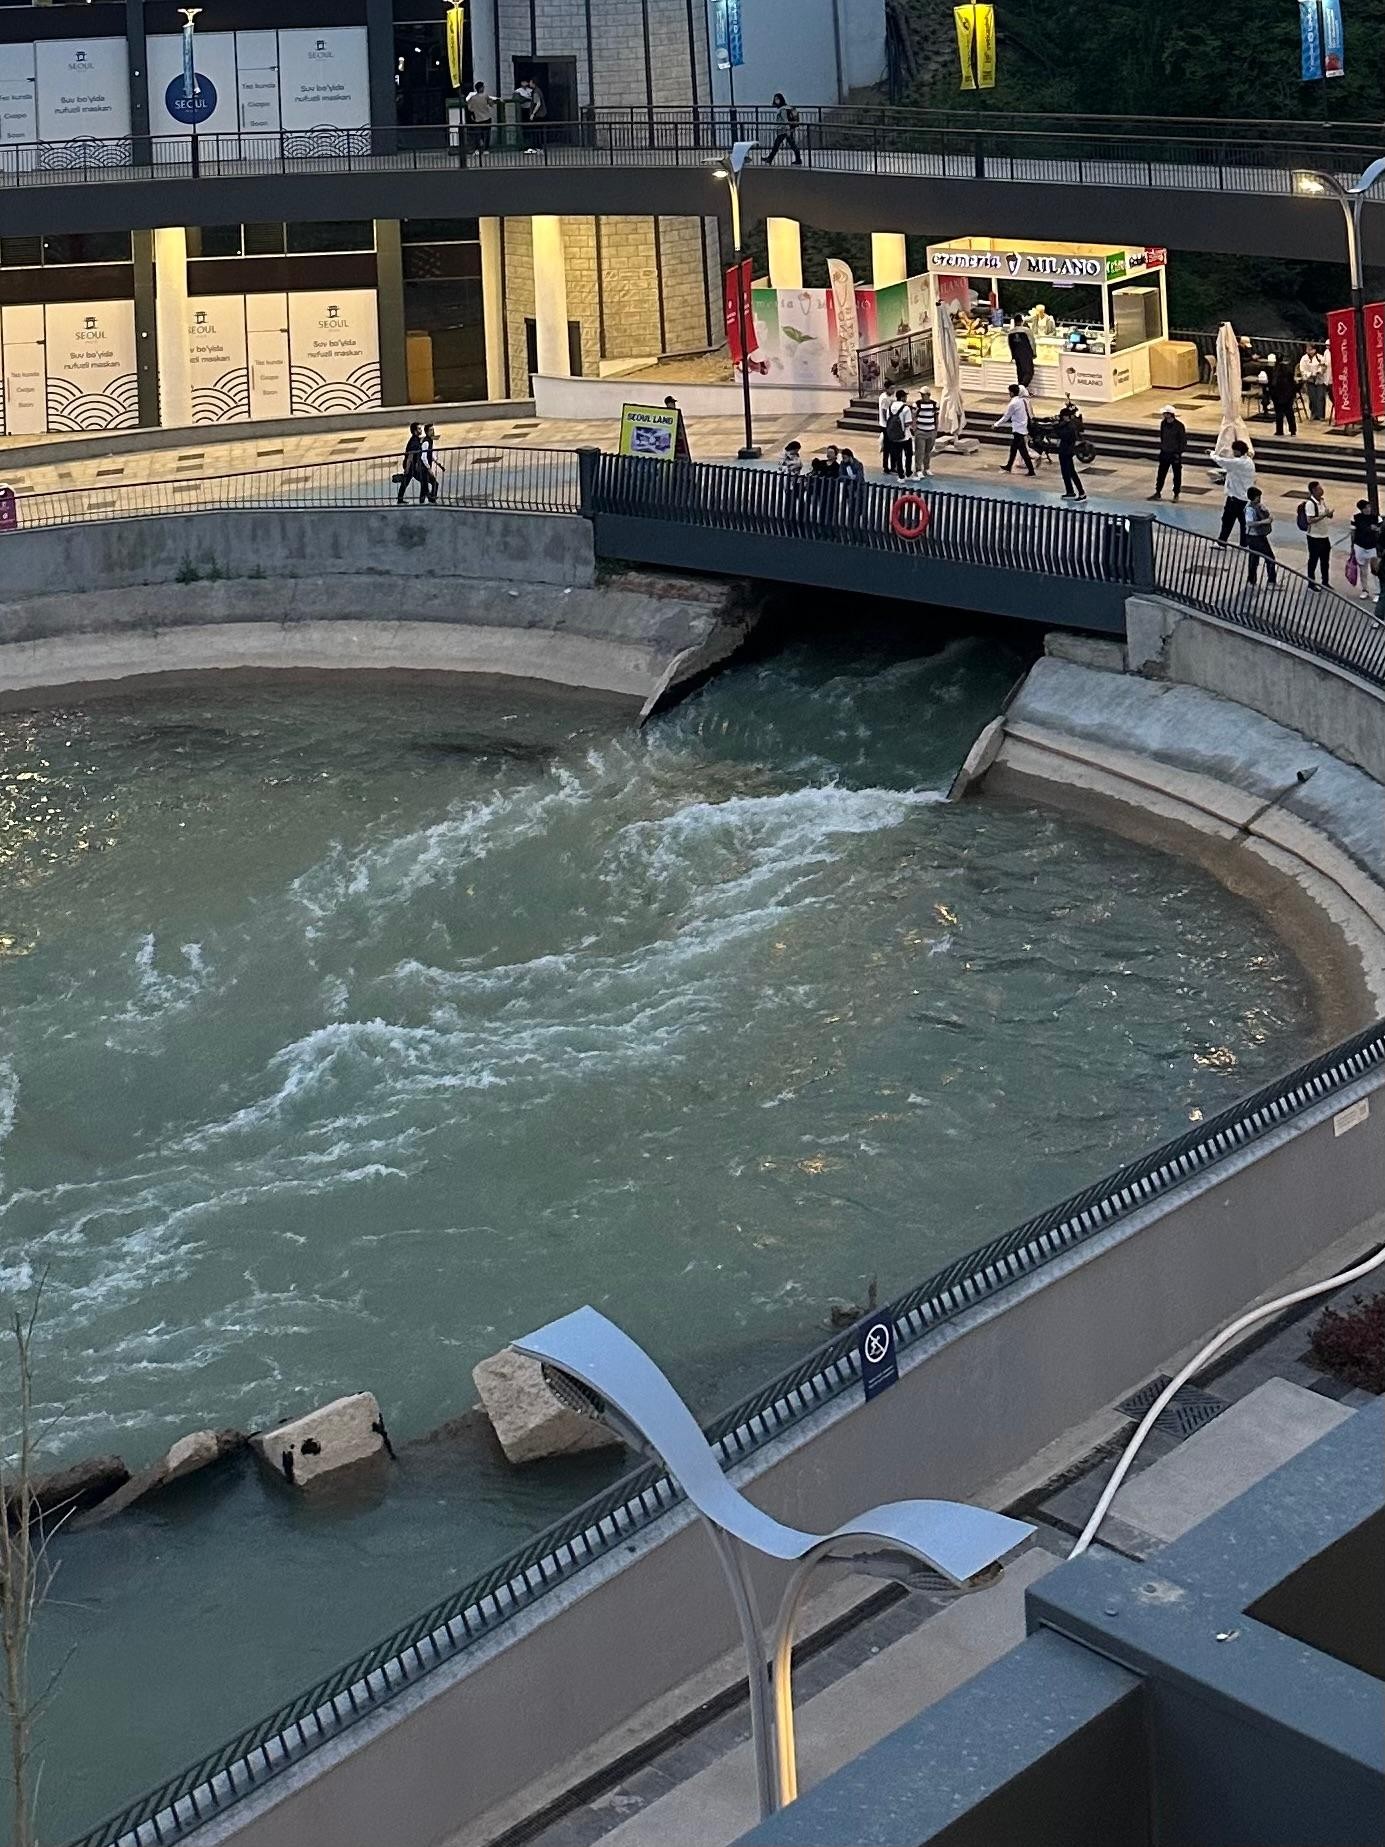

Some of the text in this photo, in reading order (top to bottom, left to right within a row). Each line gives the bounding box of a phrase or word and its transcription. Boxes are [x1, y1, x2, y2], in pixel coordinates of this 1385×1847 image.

[932, 252, 1001, 269] cremeria
[1027, 255, 1101, 276] MILANO
[318, 320, 349, 328] SEOUL
[75, 331, 107, 340] SEOUL
[1077, 378, 1104, 387] MILANO
[653, 415, 673, 424] LAND
